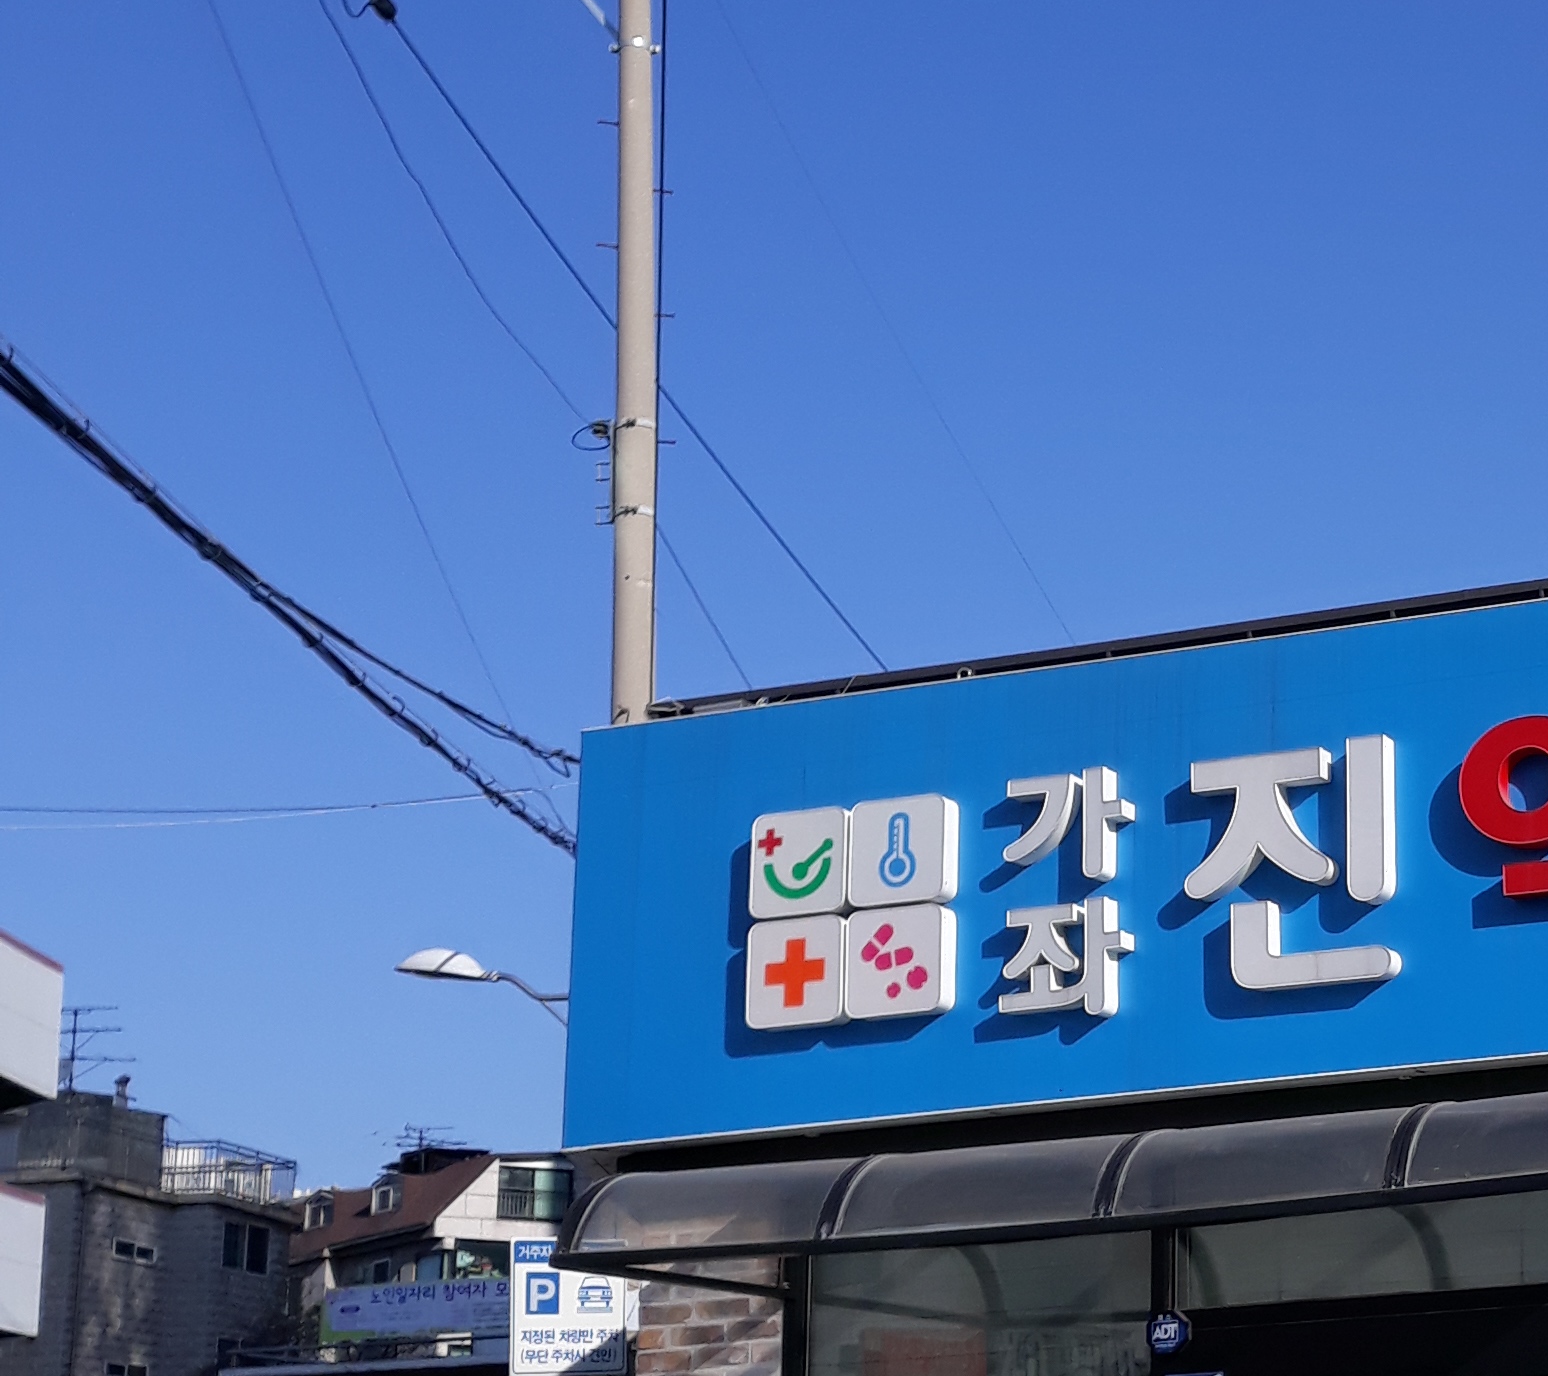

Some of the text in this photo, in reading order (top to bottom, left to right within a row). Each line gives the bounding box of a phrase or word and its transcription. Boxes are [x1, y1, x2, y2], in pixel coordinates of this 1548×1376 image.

[999, 765, 1136, 1018] 가좌
[521, 1327, 619, 1345] 지정된 차량만 주차
[1152, 1323, 1178, 1341] ADT
